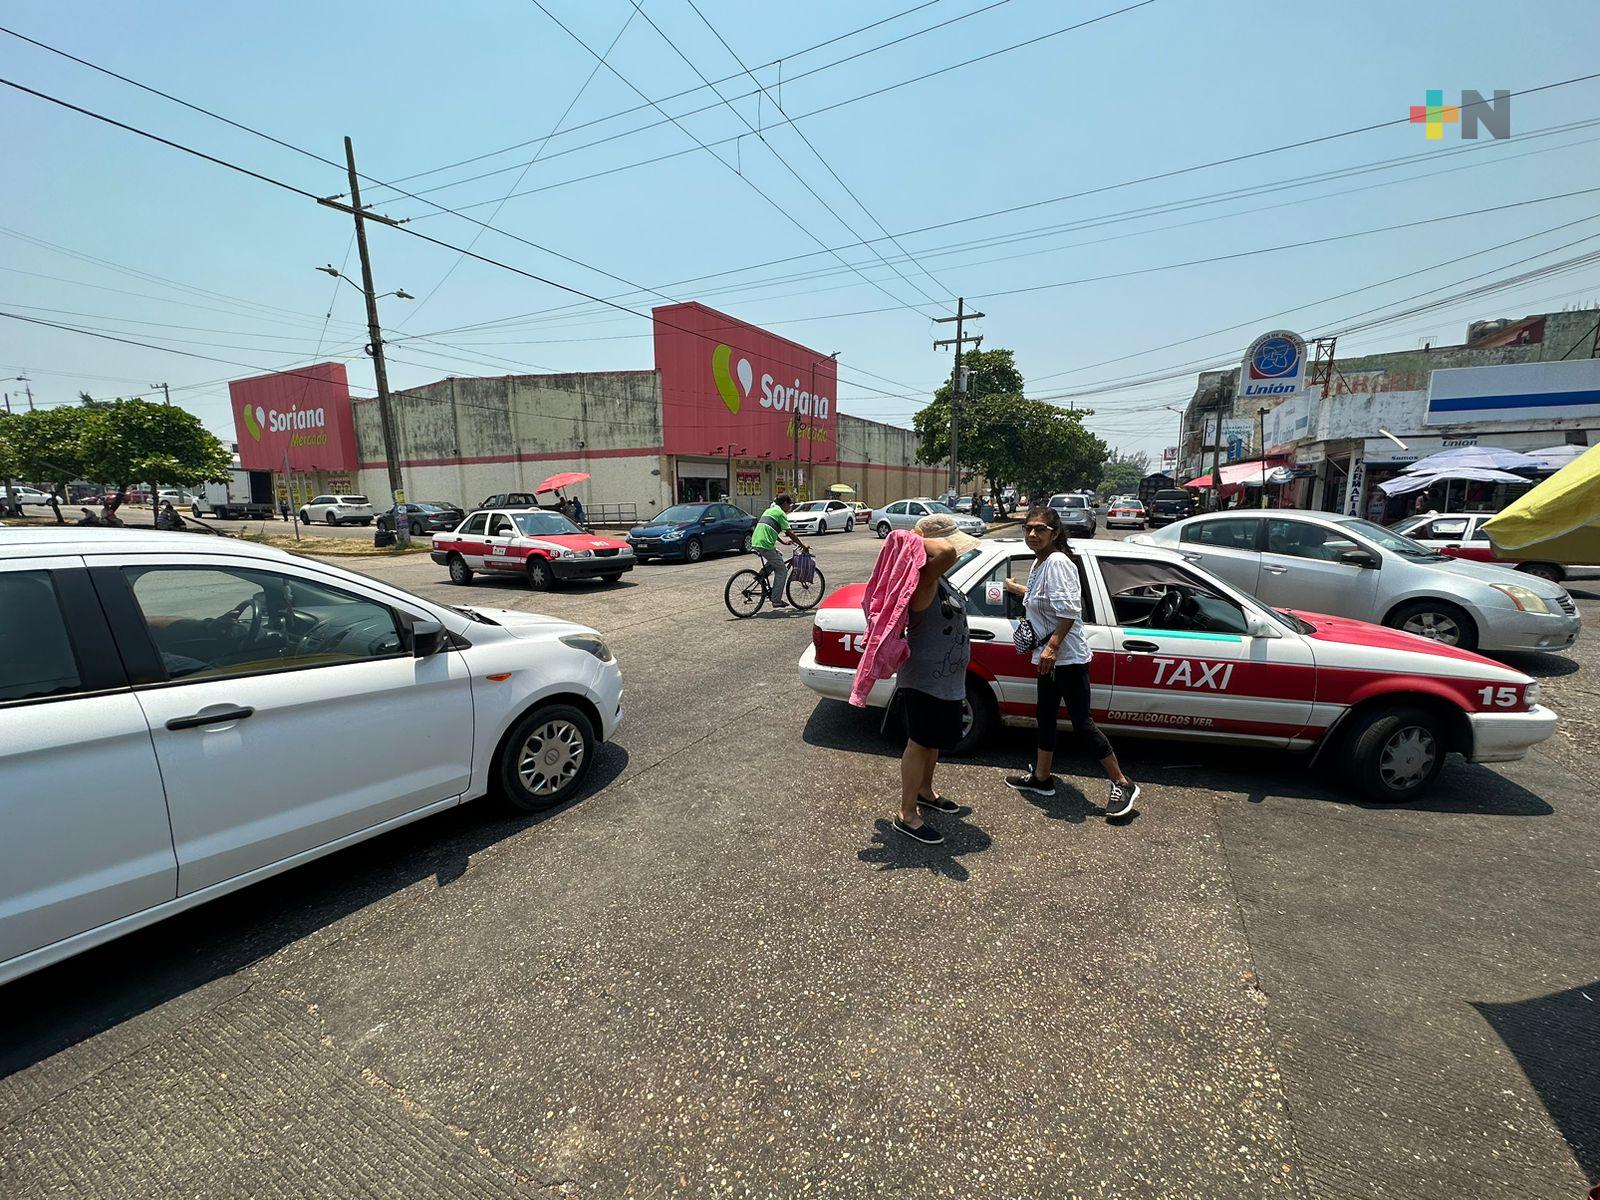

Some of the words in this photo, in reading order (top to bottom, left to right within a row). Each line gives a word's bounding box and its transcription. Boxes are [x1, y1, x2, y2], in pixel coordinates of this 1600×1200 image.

[759, 373, 829, 420] Soriana
[1245, 383, 1296, 396] Unión
[268, 404, 325, 433] Soriana
[290, 430, 328, 448] Mercado
[1348, 458, 1364, 517] FARMACIA
[838, 634, 866, 654] 15
[1152, 658, 1234, 690] TAXI
[1478, 686, 1518, 708] 15
[1107, 711, 1191, 726] COATZACOALCOS
[1192, 717, 1214, 728] VER.
